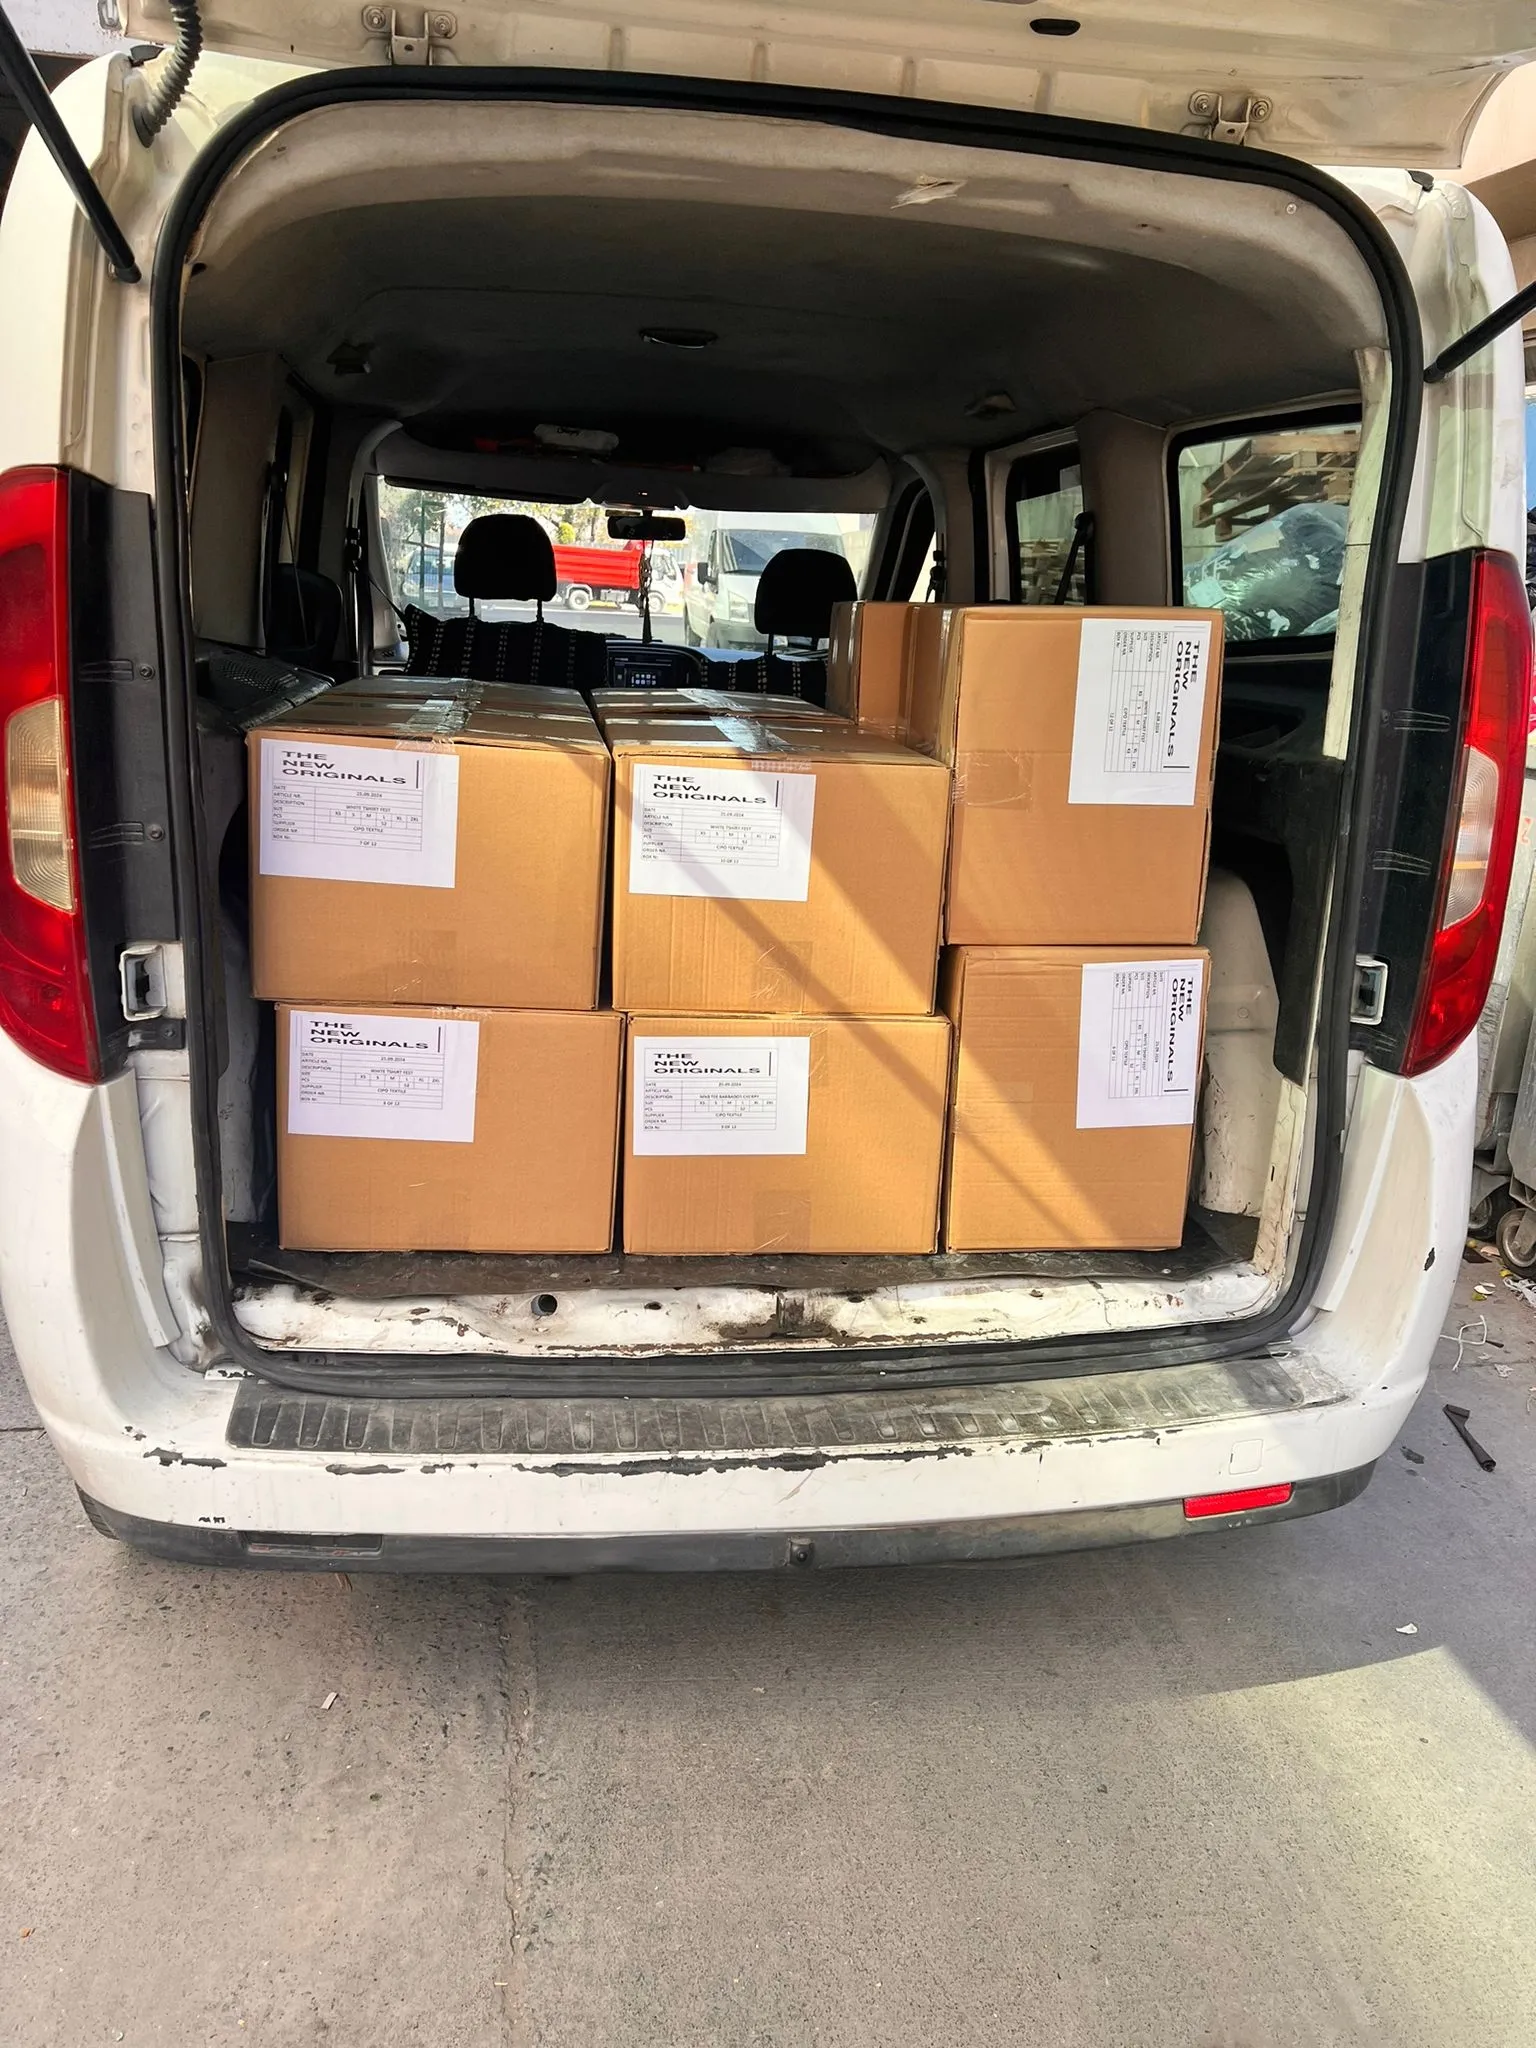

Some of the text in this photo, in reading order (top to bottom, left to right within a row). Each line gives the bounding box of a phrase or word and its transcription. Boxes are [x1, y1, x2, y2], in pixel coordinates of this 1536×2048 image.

[1182, 641, 1192, 690] NEW
[1190, 640, 1200, 683] THE
[1168, 641, 1183, 757] ORIGINALS
[281, 750, 327, 760] THE
[283, 760, 334, 769] NEW
[282, 769, 406, 784] ORIGINALS
[653, 775, 694, 783] THE
[654, 783, 700, 791] NEW
[653, 792, 766, 803] ORIGINALS
[1178, 978, 1186, 1021] NEW
[1186, 977, 1194, 1015] THE
[309, 1021, 352, 1029] THE
[1168, 978, 1178, 1081] ORIGINALS
[311, 1029, 360, 1037] NEW
[310, 1037, 428, 1049] ORIGINALS
